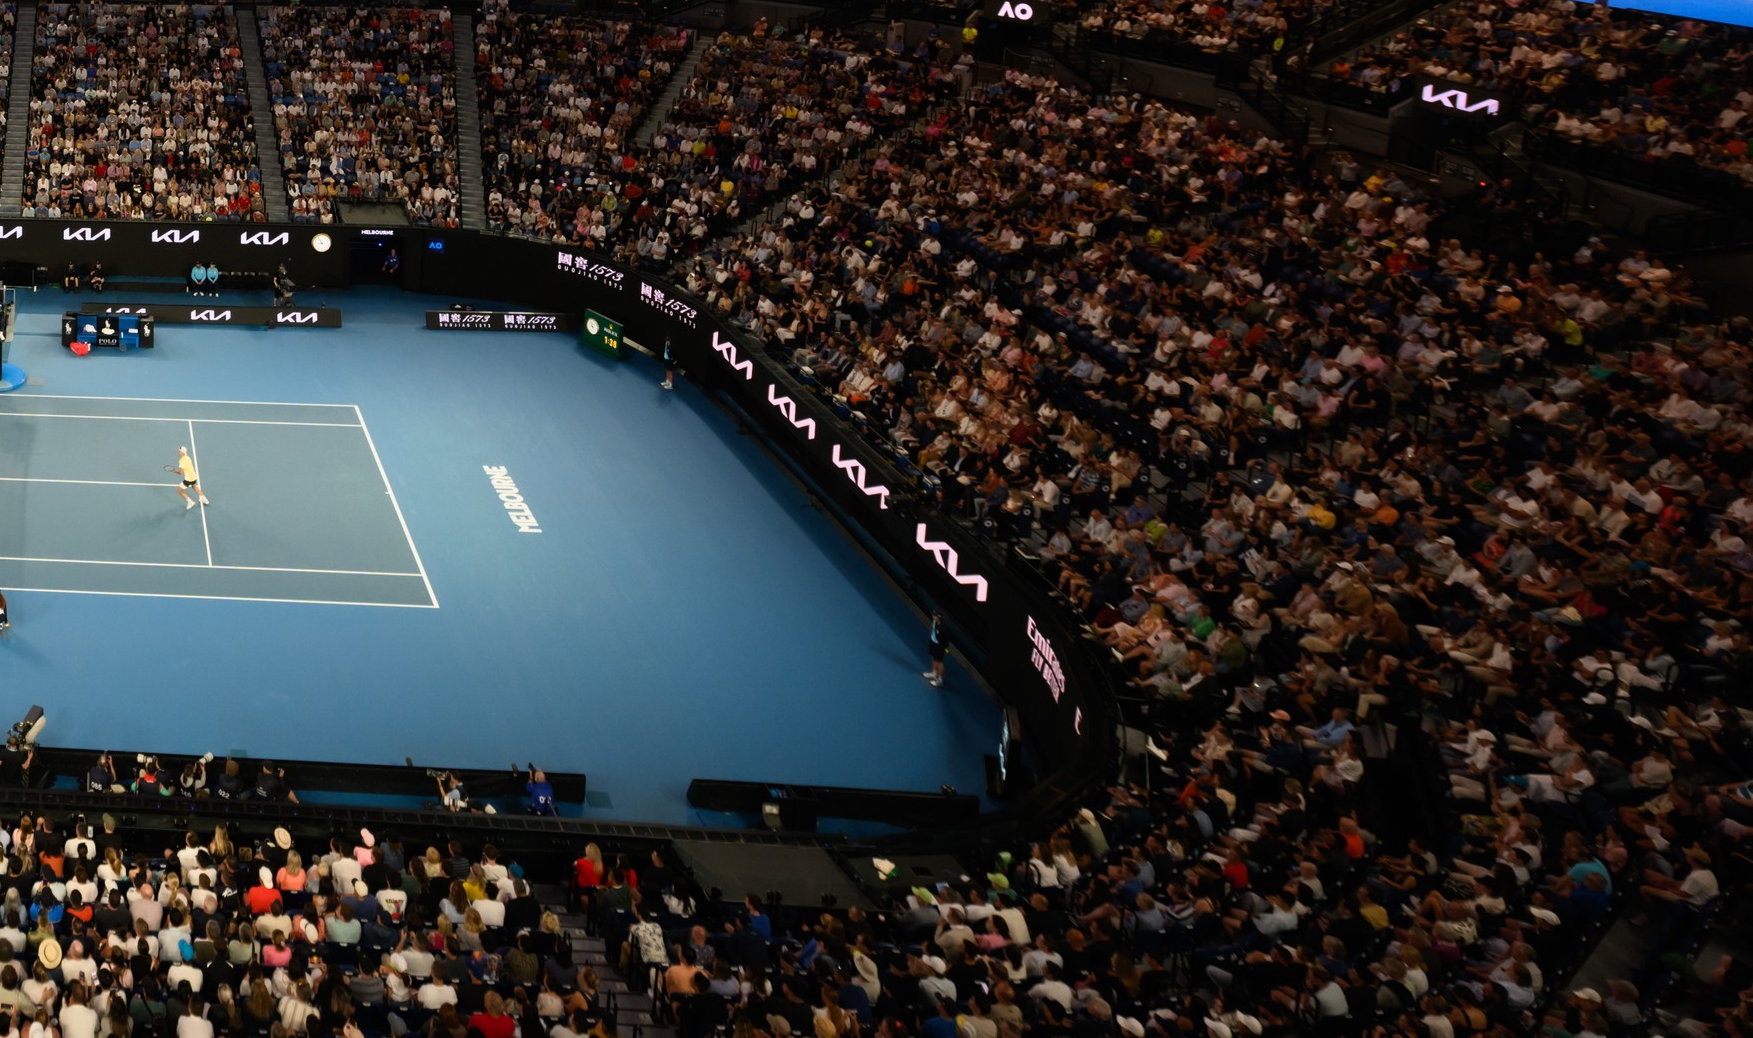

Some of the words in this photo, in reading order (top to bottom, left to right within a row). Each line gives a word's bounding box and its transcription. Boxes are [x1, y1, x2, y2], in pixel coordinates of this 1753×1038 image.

[998, 1, 1033, 21] AO
[1422, 84, 1499, 116] KIA
[63, 227, 111, 241] KIA
[152, 229, 200, 243] KIA
[240, 231, 289, 246] KIA
[191, 309, 232, 321] KIA
[277, 311, 318, 323] KIA
[712, 331, 753, 380] KIA
[768, 383, 816, 440] KIA
[832, 444, 890, 510] KIA
[482, 465, 543, 533] MELBOURNE
[916, 523, 989, 602] KIA
